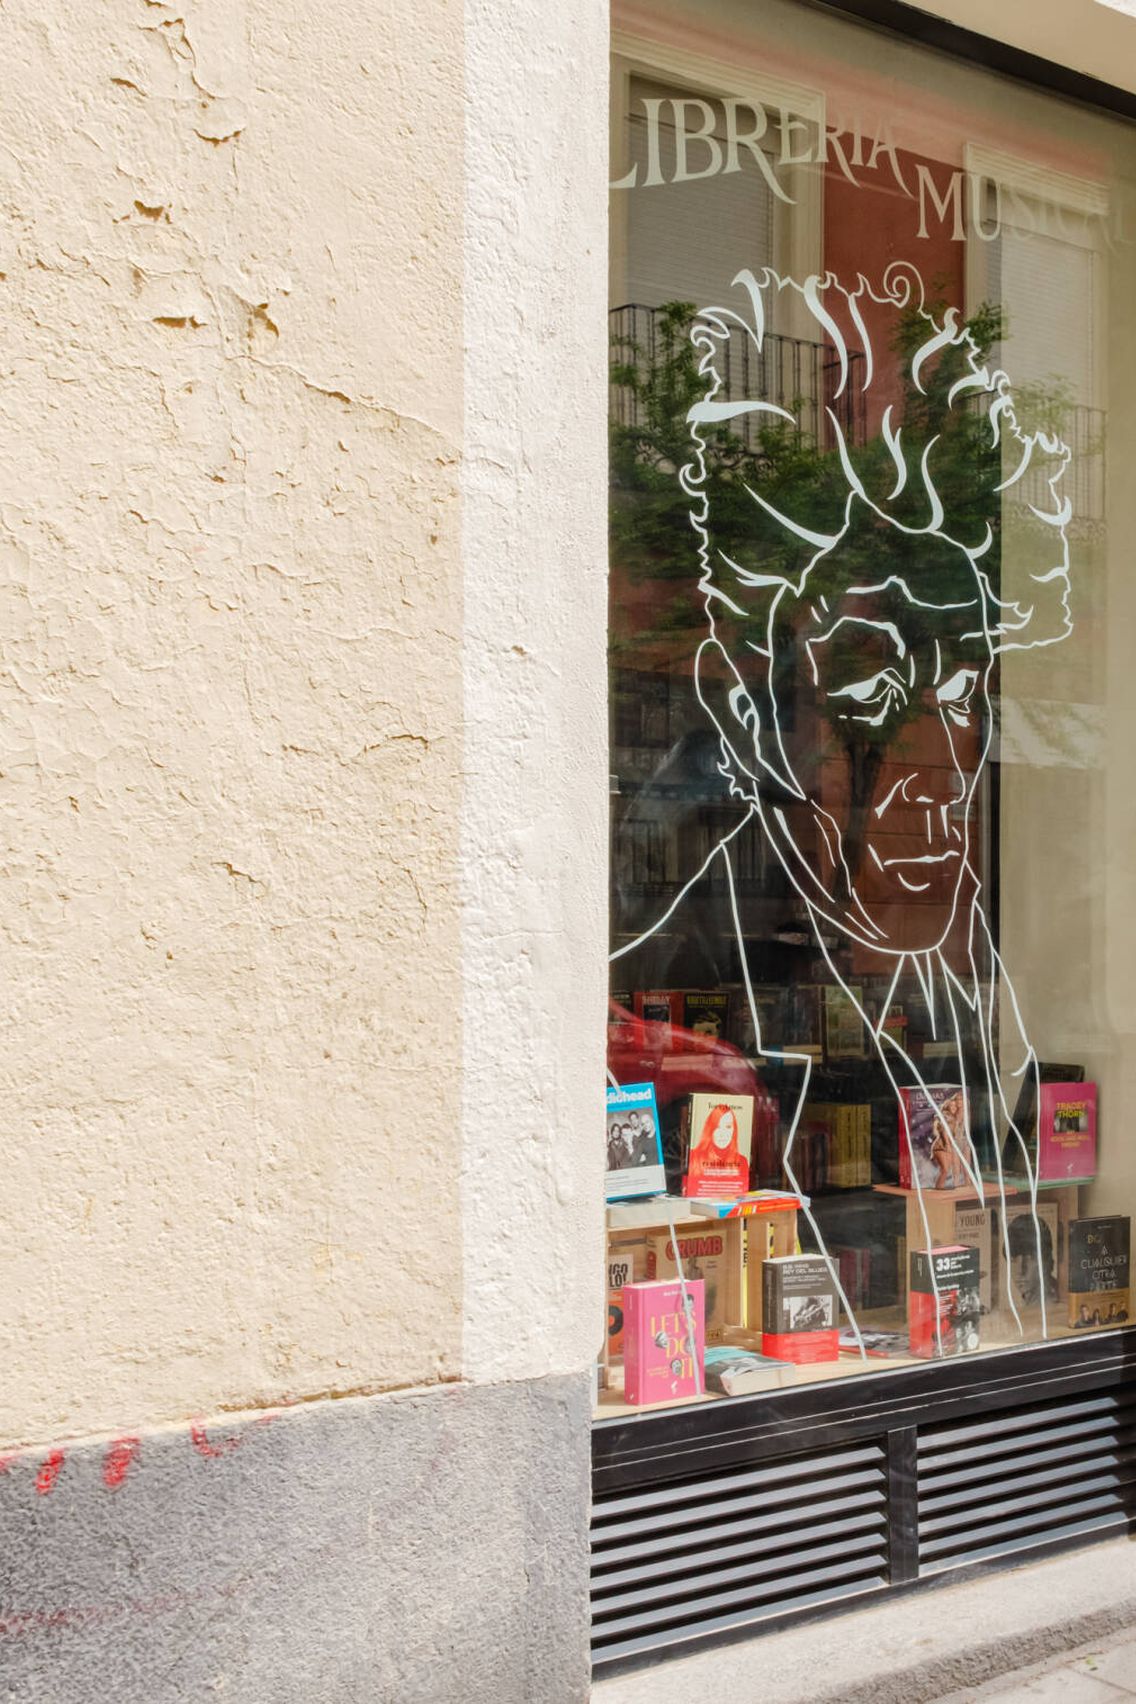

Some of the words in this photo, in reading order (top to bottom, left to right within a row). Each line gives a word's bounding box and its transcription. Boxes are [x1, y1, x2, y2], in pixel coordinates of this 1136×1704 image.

[609, 97, 914, 204] IBRERIA
[960, 1214, 986, 1226] YOUNG
[665, 1235, 723, 1261] CRUMB
[936, 1257, 950, 1272] 33
